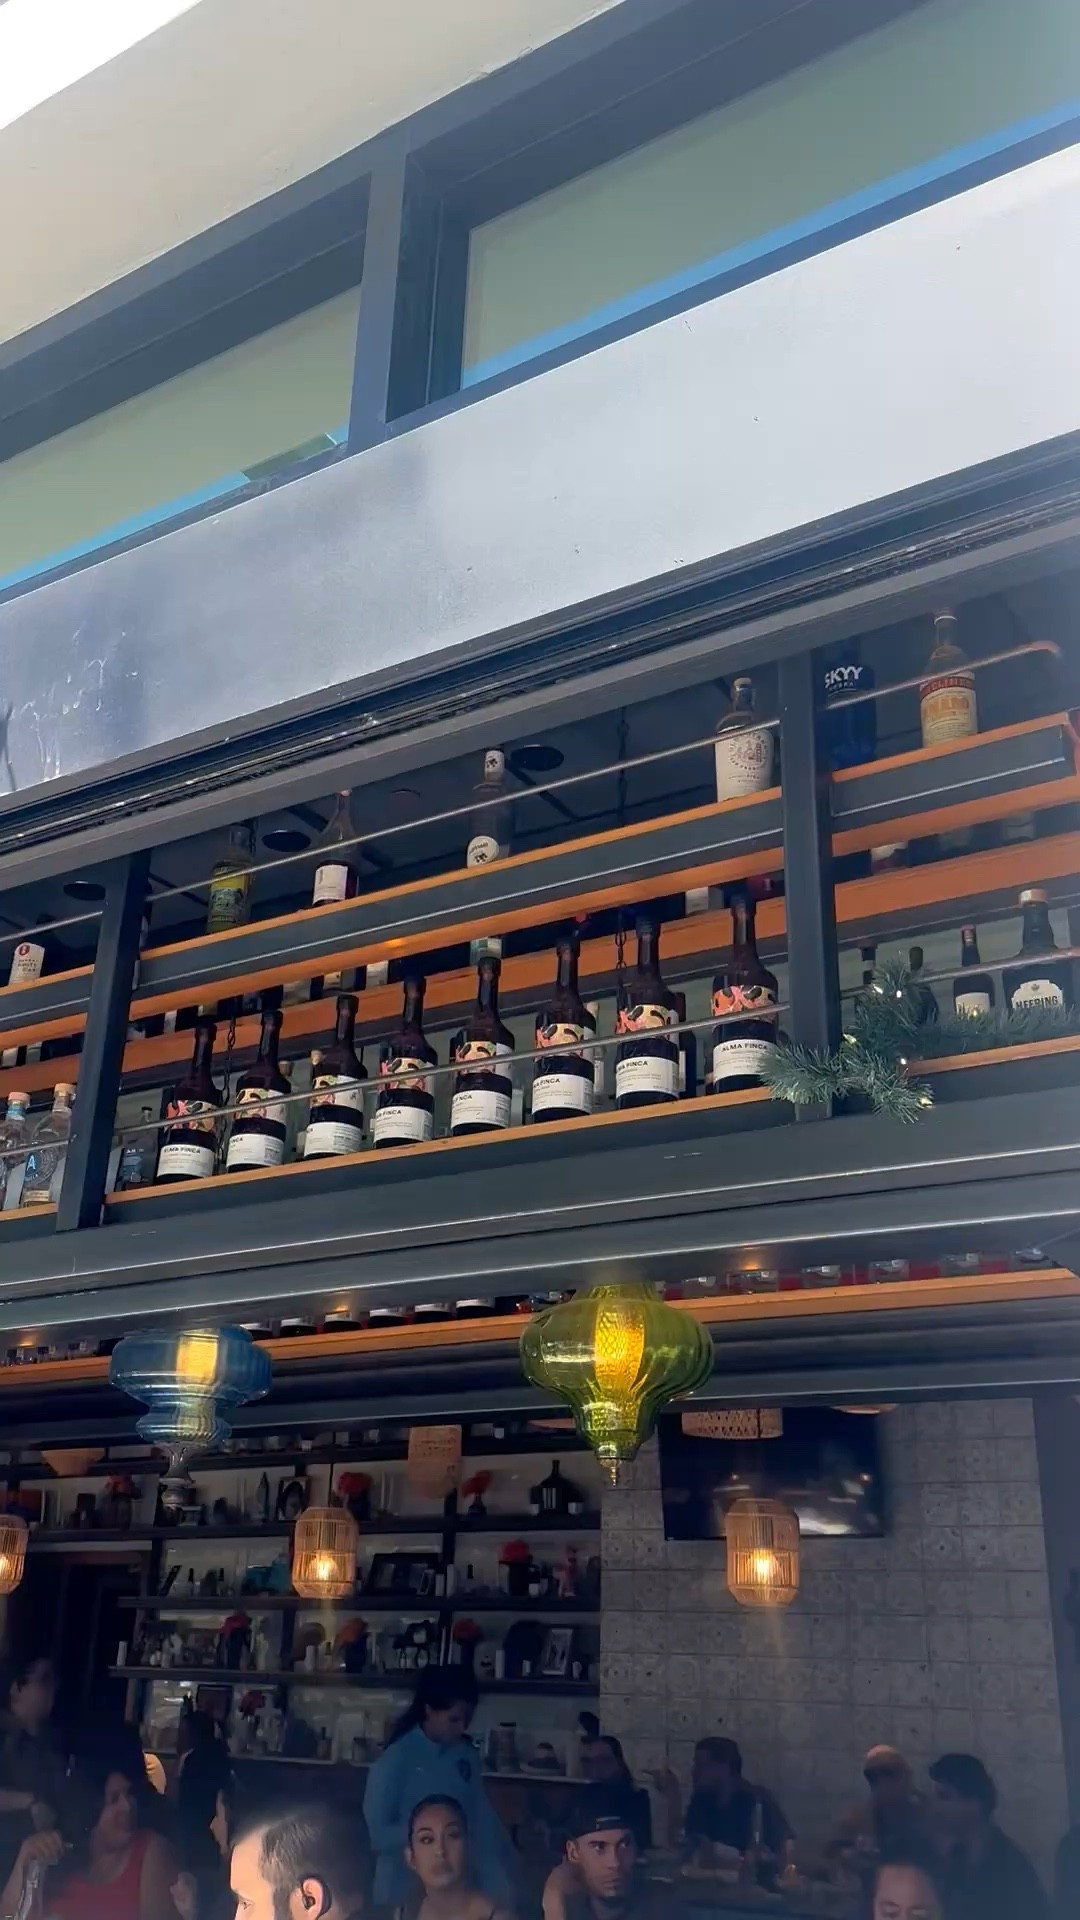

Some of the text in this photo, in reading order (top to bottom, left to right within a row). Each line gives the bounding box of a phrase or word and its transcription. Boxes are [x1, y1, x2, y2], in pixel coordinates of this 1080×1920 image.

[824, 665, 864, 689] SKYY
[721, 1043, 743, 1052] ALMA
[540, 1078, 561, 1086] FINCA
[382, 1109, 402, 1117] FINCA
